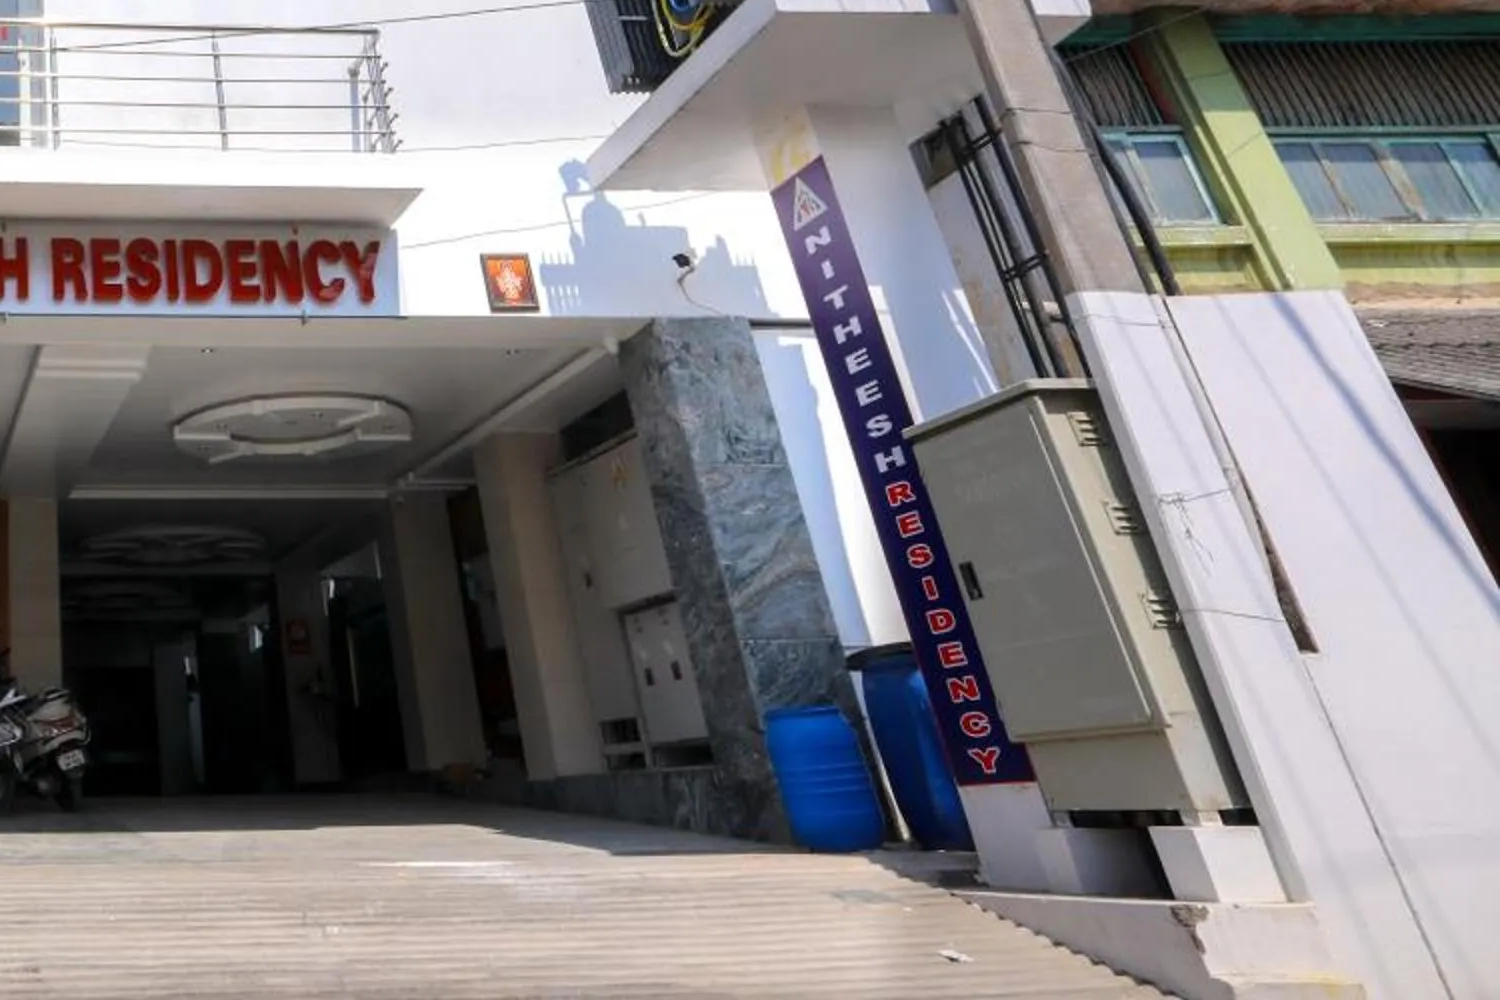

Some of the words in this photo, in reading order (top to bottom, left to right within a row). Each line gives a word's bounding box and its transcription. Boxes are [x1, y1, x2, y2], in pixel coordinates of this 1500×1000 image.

[50, 237, 381, 304] RESIDENCY
[804, 225, 907, 474] NITHEESH
[885, 480, 1000, 775] RESIDENCY
